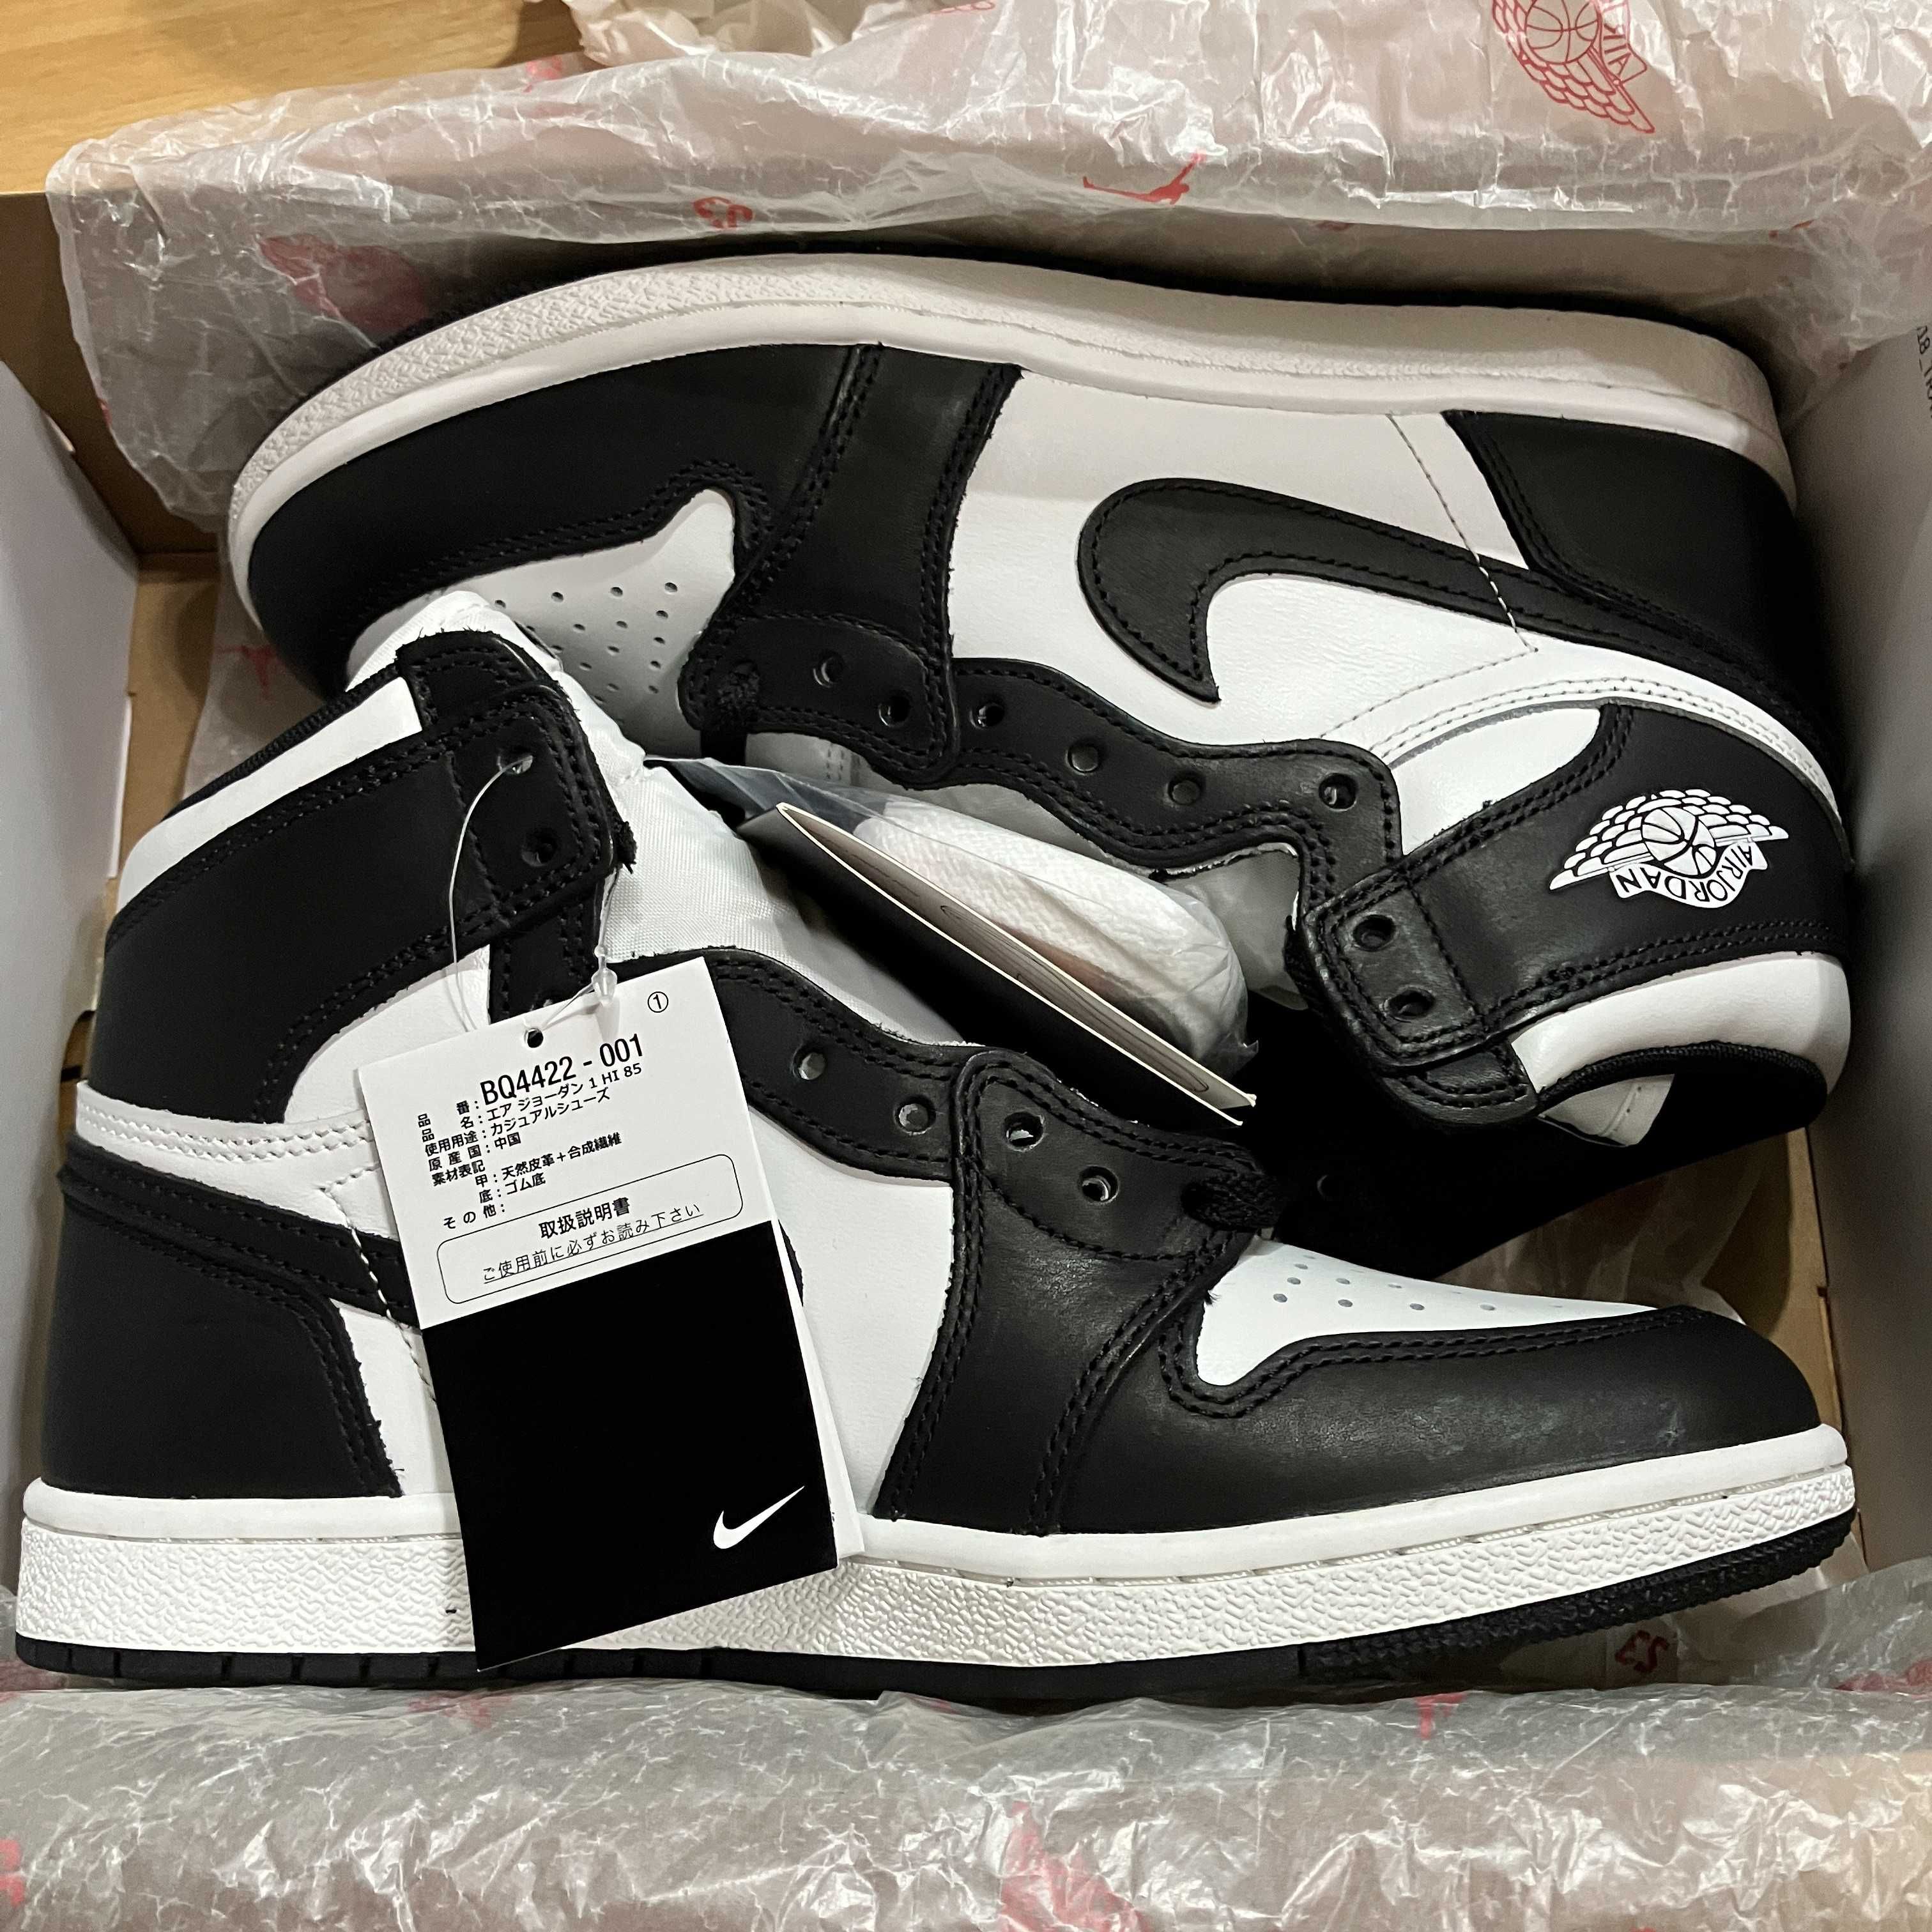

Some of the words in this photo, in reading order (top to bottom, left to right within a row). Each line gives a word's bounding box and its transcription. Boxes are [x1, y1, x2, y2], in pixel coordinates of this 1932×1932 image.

[494, 1132, 521, 1149] 中国
[432, 1160, 486, 1186] 素材表記
[505, 1172, 546, 1195] ゴム底
[539, 1197, 630, 1239] 取扱説明書
[482, 1204, 701, 1282] ご使用前に必ずお読み下さい
